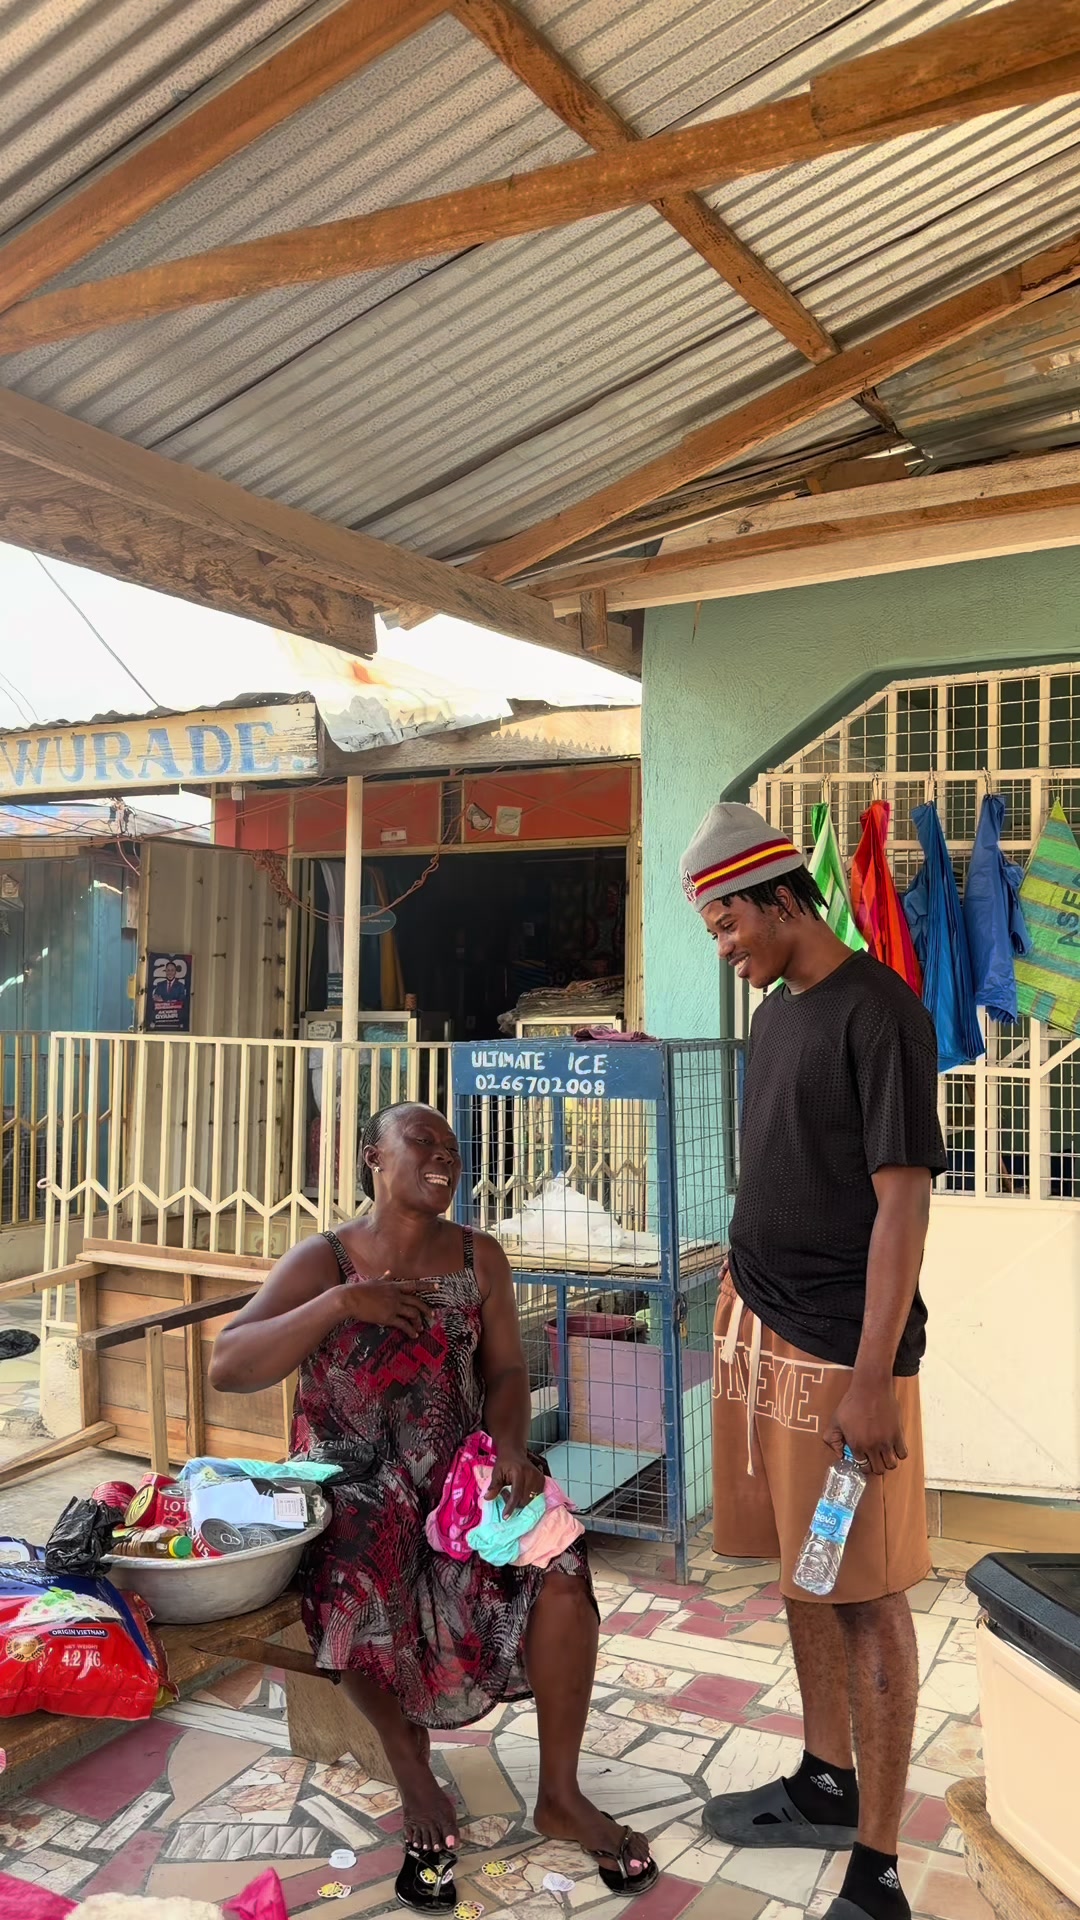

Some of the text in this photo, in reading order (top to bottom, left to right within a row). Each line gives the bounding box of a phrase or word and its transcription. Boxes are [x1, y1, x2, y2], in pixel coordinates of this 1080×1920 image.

[1057, 873, 1080, 948] ASE
[471, 1050, 608, 1075] ULTIMATE ICE
[475, 1073, 606, 1097] 0266702008
[52, 1628, 105, 1637] ORIGIN VIETNAM
[62, 1649, 101, 1668] 4.2 KG
[810, 1775, 844, 1797] adidas
